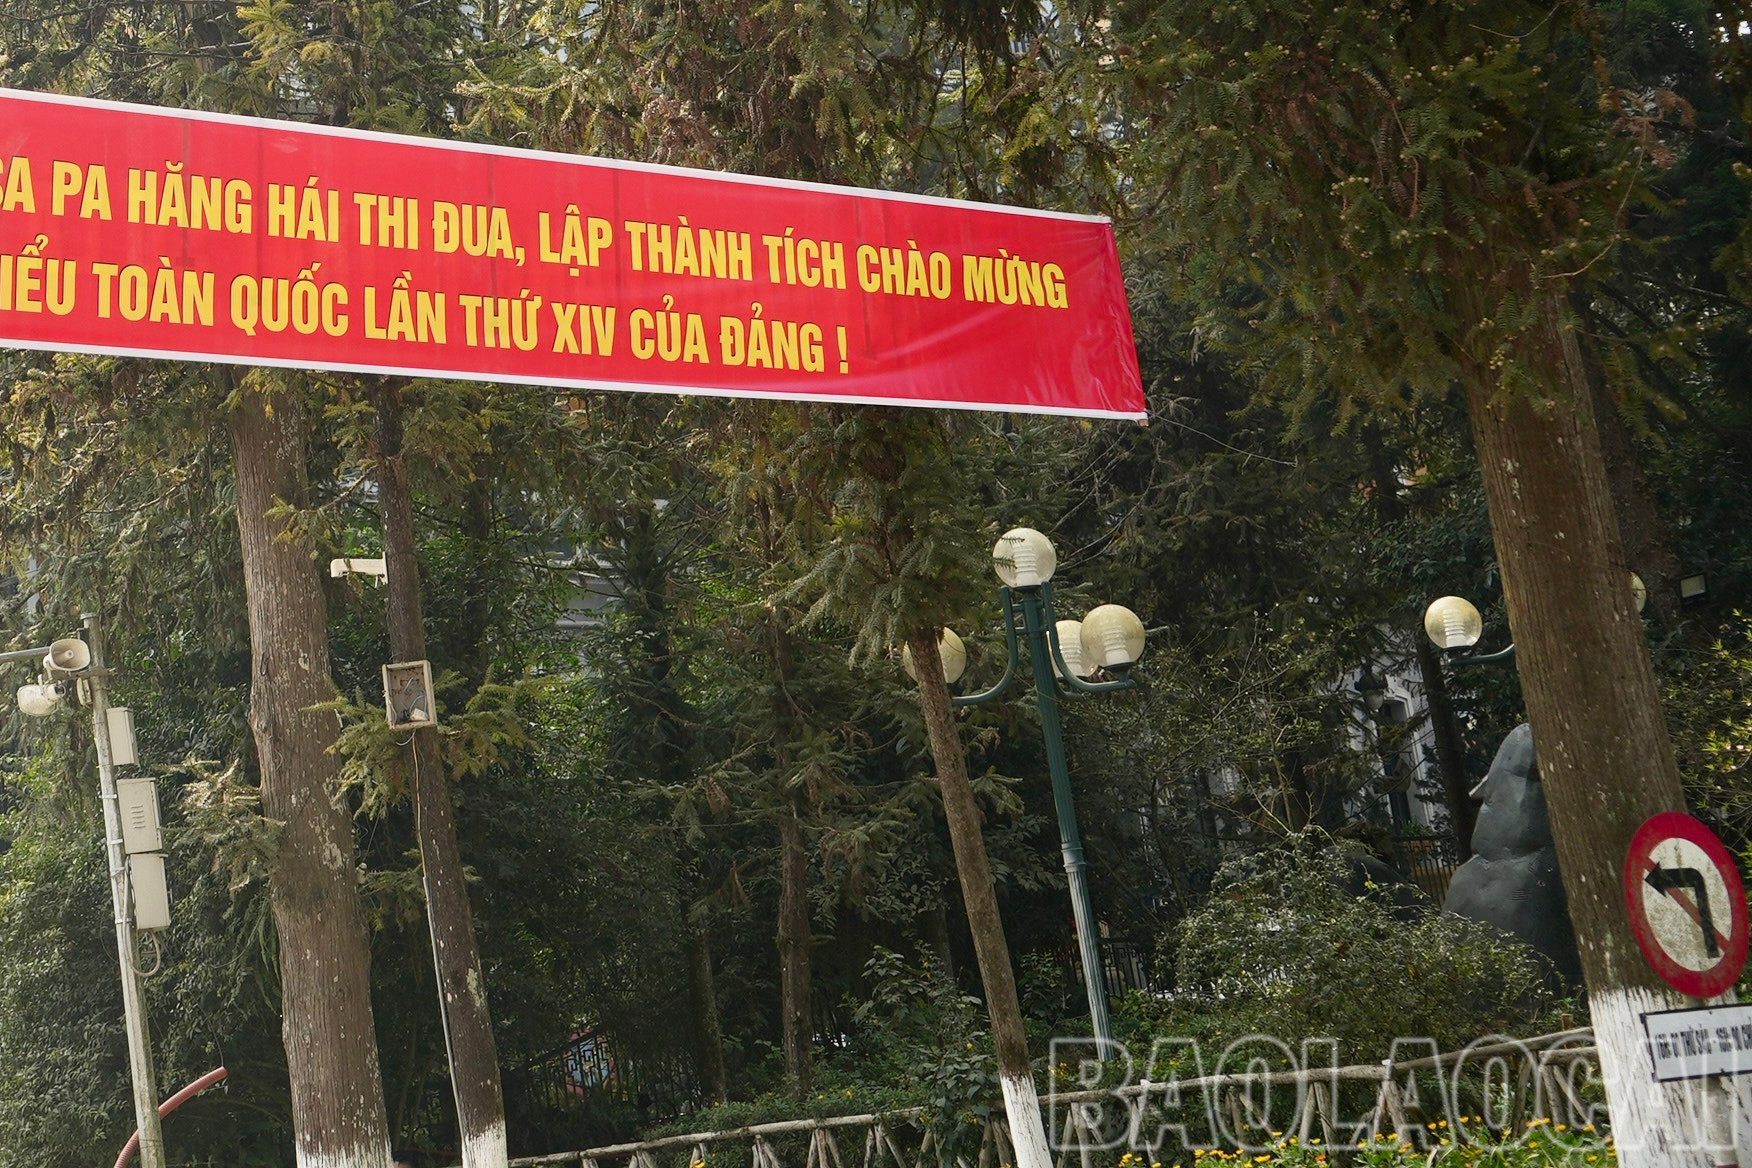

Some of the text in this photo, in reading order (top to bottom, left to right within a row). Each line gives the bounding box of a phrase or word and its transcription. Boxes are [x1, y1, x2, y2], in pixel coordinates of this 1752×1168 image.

[52, 161, 112, 220] PA
[128, 162, 252, 236] HĂNG
[269, 177, 339, 242] HÁI
[354, 193, 418, 250] THI
[432, 202, 525, 266] ĐUA,
[540, 205, 612, 276] LẬP
[626, 216, 752, 280] THÀNH
[763, 227, 846, 289] TÍCH
[857, 240, 951, 299] CHÀO
[963, 248, 1068, 308] MỪNG
[93, 257, 214, 326] TOÀN
[231, 263, 348, 336] QUỐC
[365, 278, 446, 344] LẦN
[460, 289, 542, 351] THỨ
[552, 303, 616, 356] XIV
[630, 295, 709, 363] CỦA
[720, 303, 824, 372] ĐẢNG
